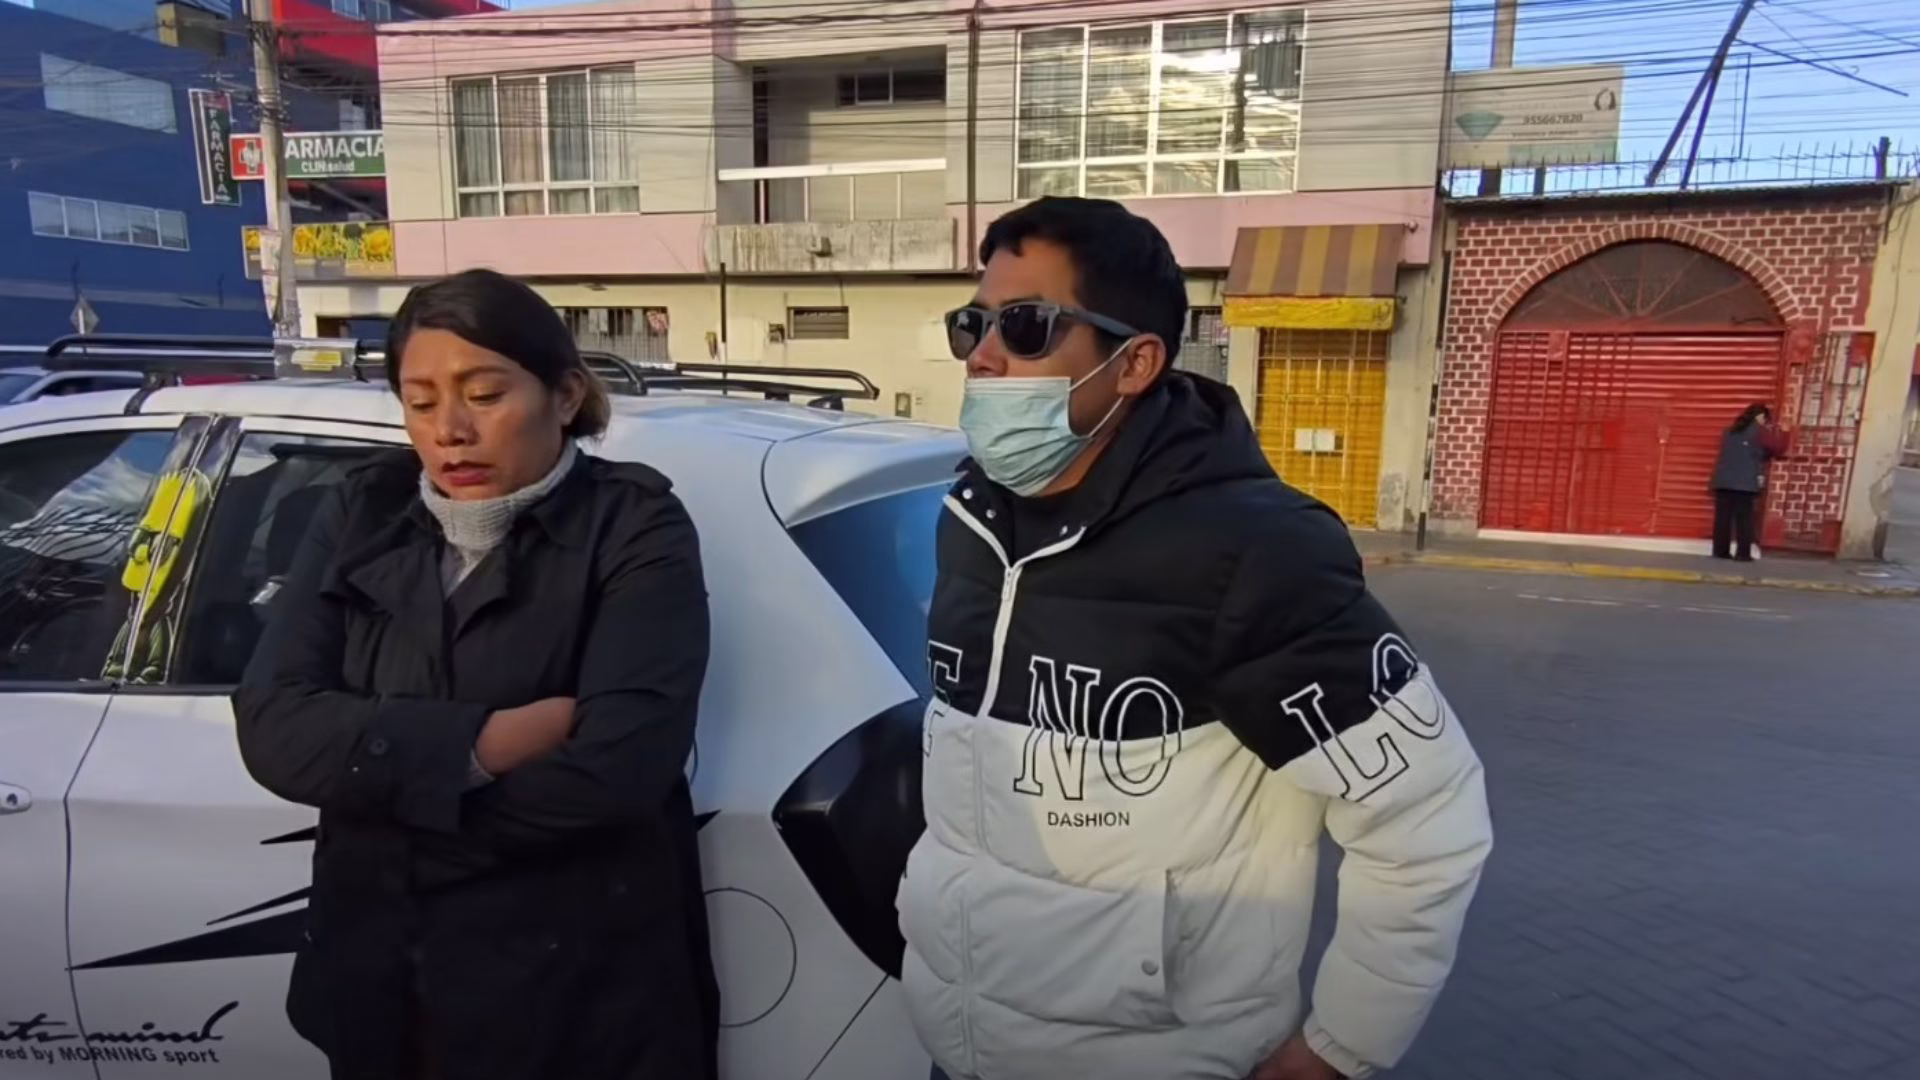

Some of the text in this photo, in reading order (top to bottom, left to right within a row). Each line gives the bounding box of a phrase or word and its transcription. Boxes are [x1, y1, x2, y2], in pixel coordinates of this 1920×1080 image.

[208, 109, 229, 194] FARMACIA
[284, 136, 385, 159] ARMACIA
[1047, 811, 1131, 828] DASHION
[30, 1045, 54, 1065] by
[58, 1046, 157, 1062] MORNING
[162, 1048, 220, 1066] sport
